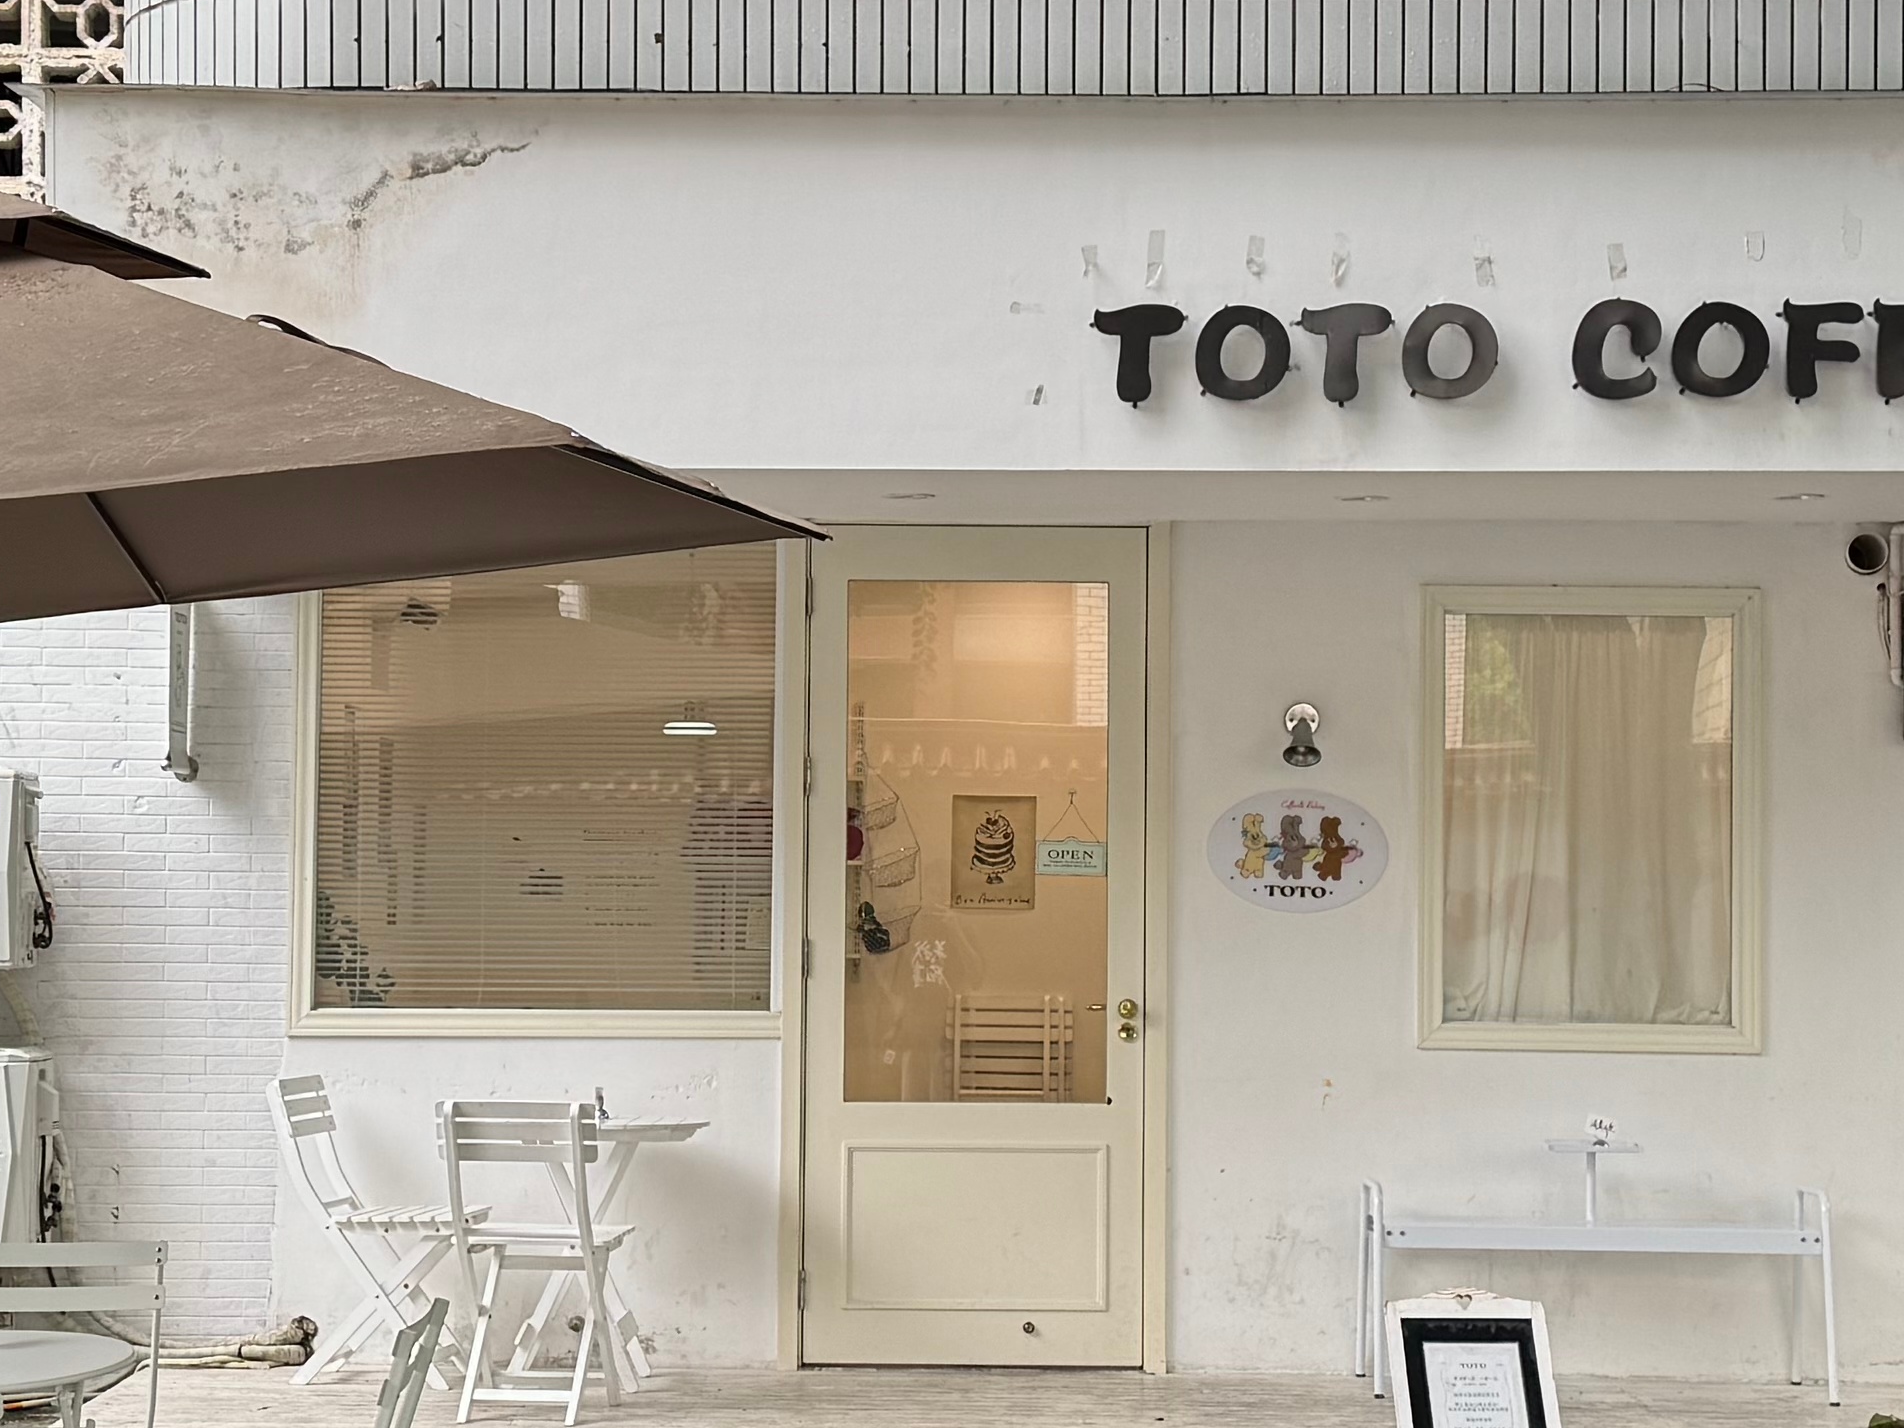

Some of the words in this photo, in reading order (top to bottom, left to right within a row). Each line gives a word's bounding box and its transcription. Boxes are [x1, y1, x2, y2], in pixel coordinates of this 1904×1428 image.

[1092, 302, 1499, 403] TOTO
[1047, 849, 1094, 860] OPEN
[1264, 884, 1327, 899] TOTO
